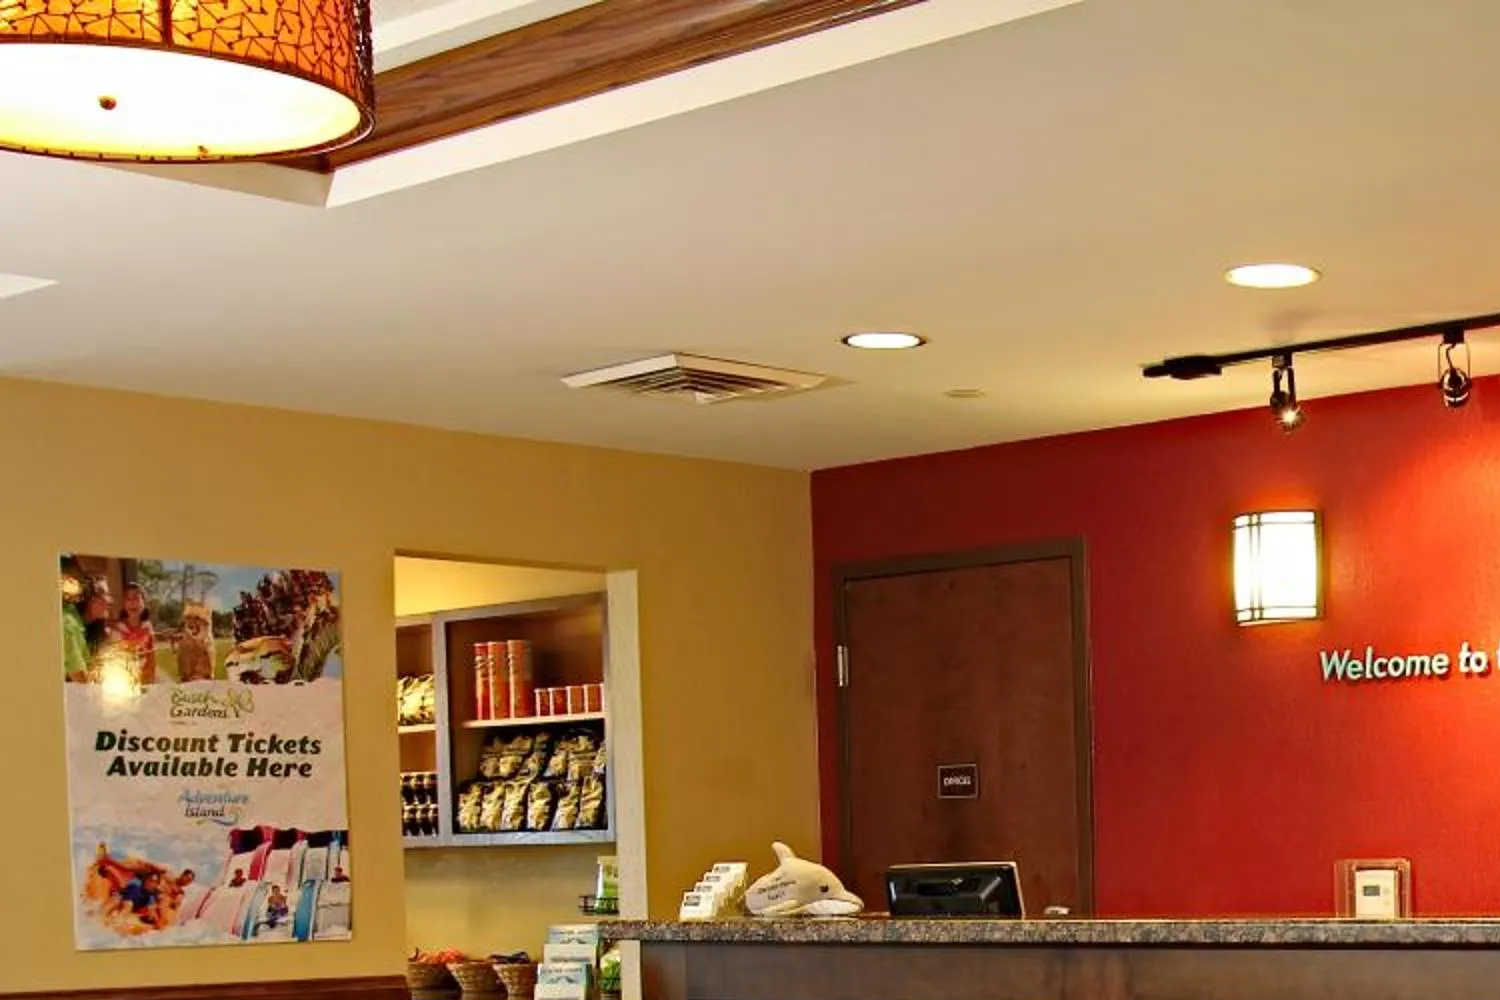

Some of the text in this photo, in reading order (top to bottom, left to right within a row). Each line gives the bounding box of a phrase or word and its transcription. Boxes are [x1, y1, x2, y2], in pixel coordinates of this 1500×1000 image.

[1320, 646, 1449, 681] Welcome
[1458, 641, 1487, 673] to
[95, 729, 322, 755] Discount Tickets
[107, 754, 312, 778] Available Here
